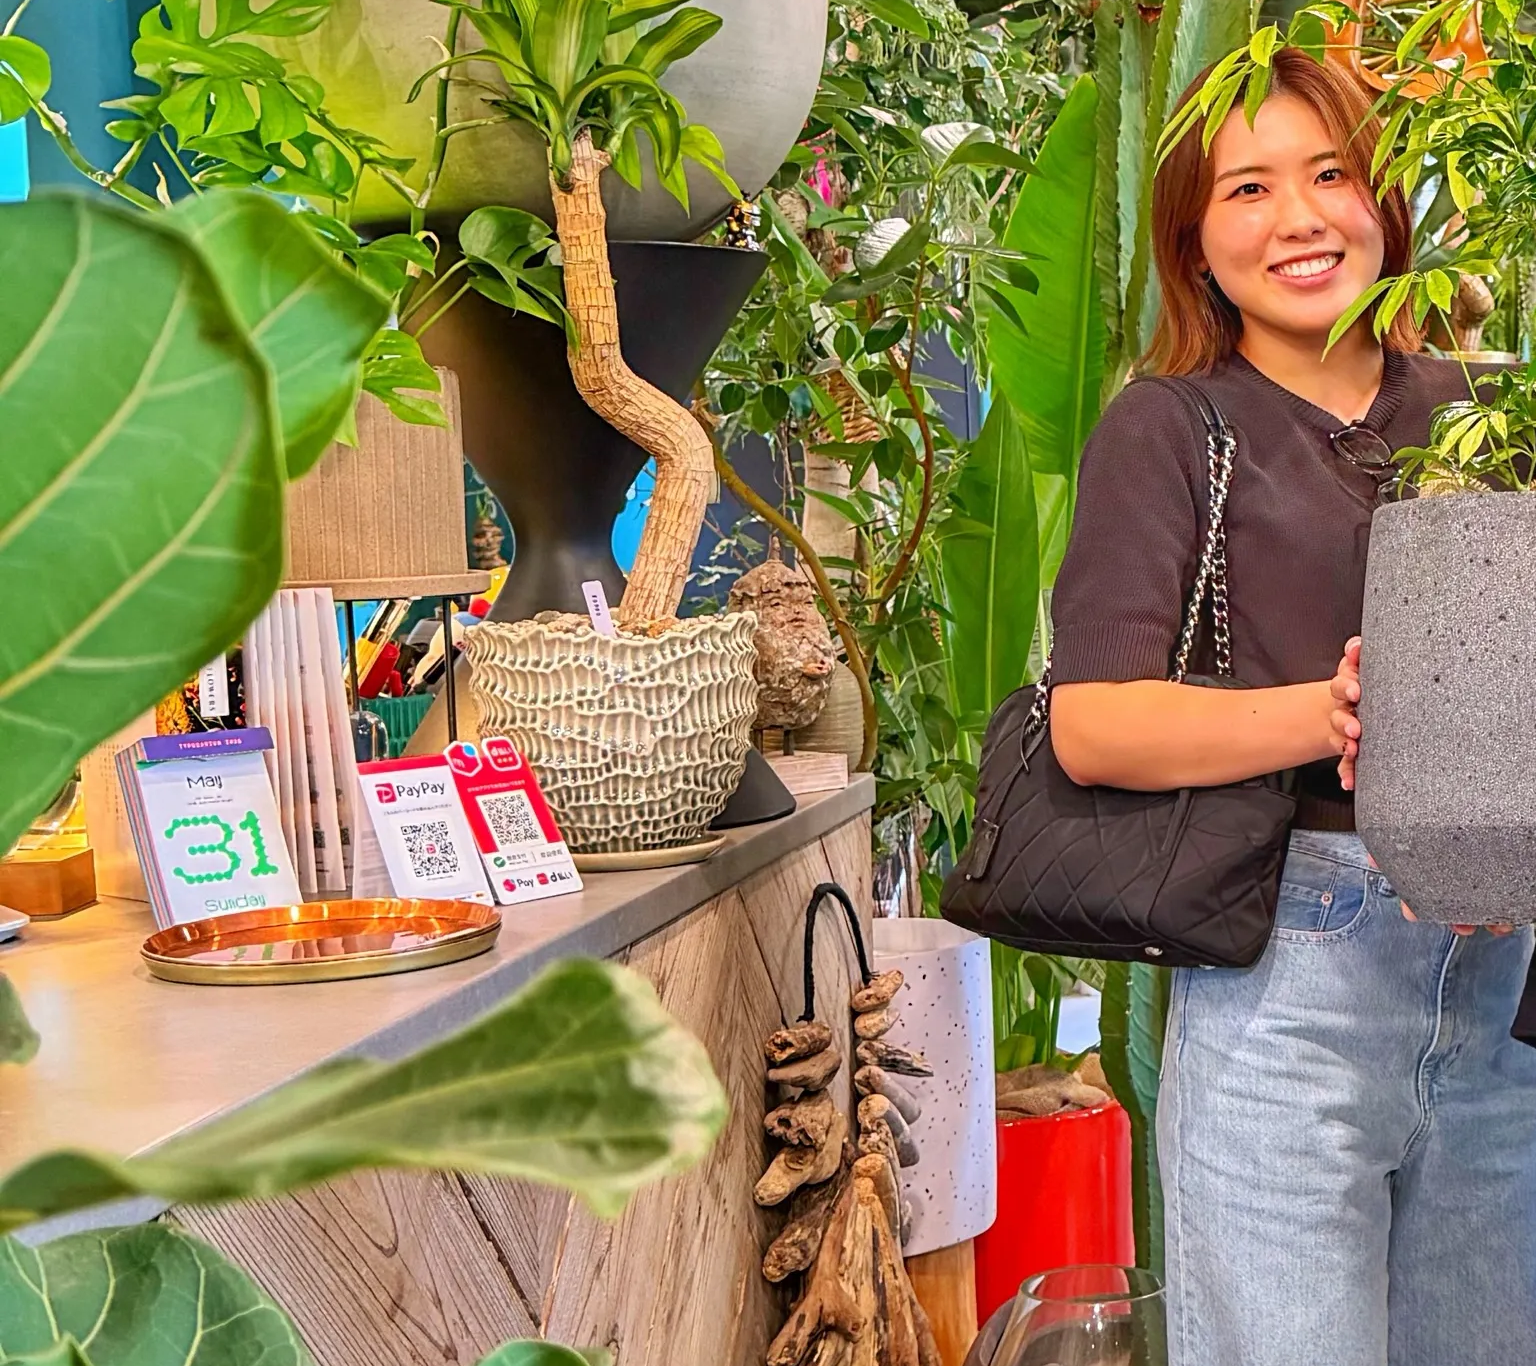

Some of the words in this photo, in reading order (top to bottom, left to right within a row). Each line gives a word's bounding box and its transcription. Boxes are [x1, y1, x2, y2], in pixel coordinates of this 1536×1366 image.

[186, 775, 223, 789] May
[396, 781, 446, 798] PayPay
[164, 810, 279, 885] 31
[516, 878, 534, 888] Pay
